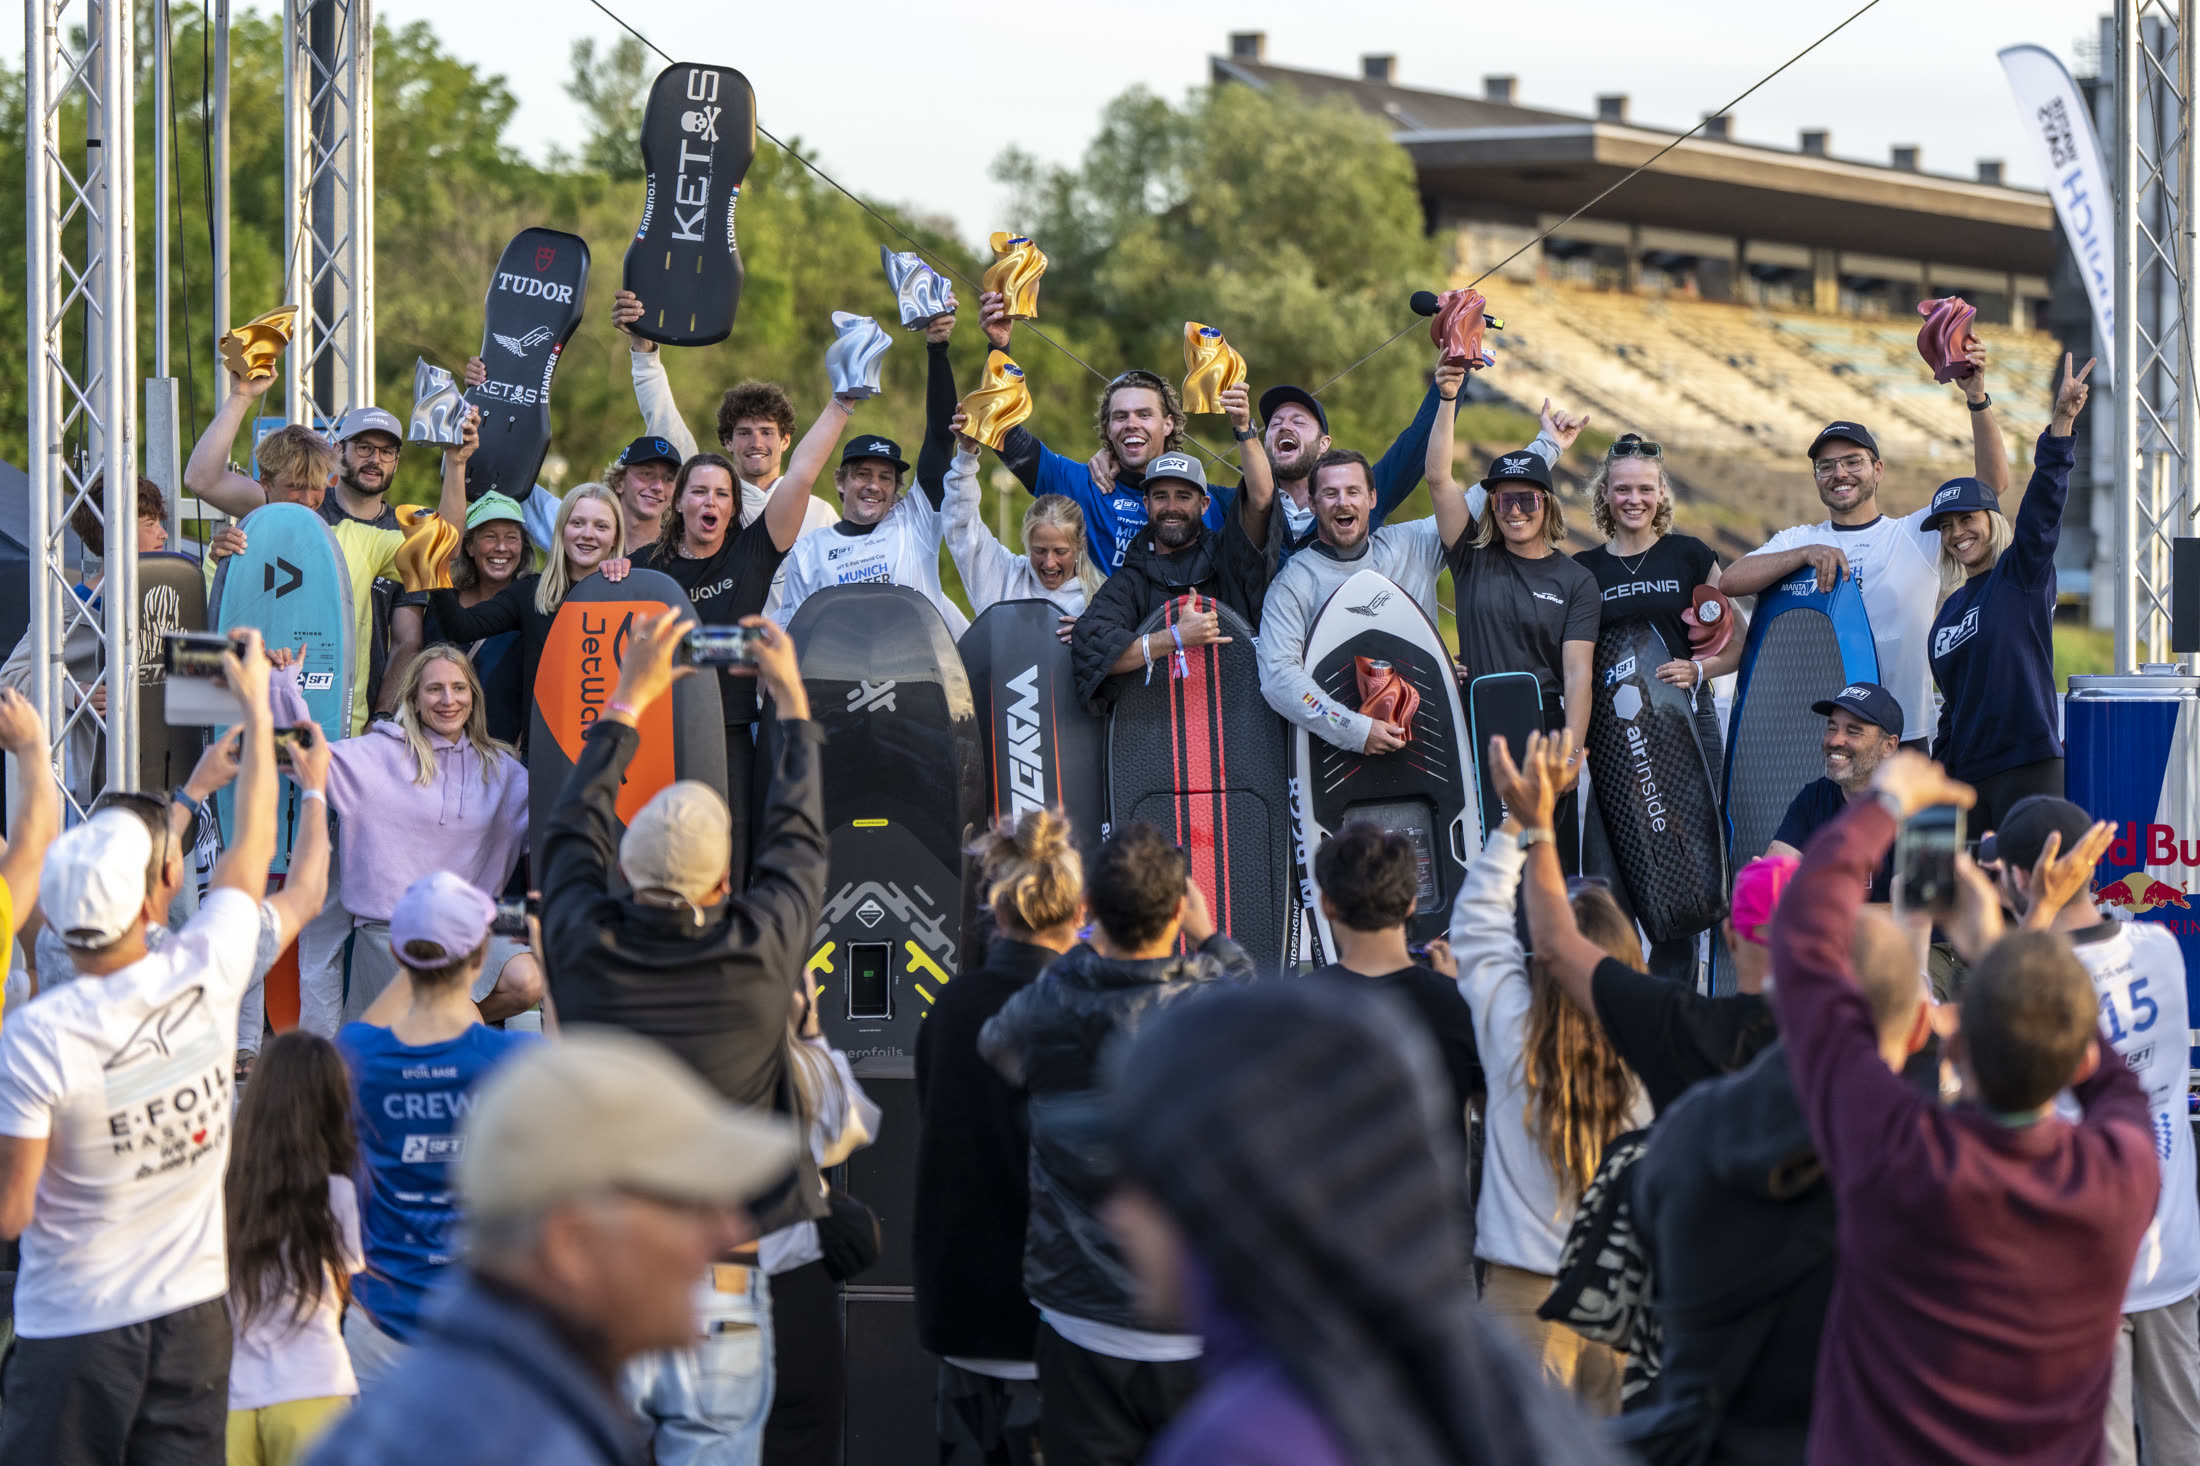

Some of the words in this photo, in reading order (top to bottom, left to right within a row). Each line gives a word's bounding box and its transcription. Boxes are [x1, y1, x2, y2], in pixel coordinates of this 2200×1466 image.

[498, 272, 574, 304] TUDOR
[838, 562, 888, 584] MUNICH
[1781, 583, 1807, 592] MANTA
[1617, 659, 1635, 675] SFT
[309, 675, 332, 684] SFT
[1850, 688, 1867, 697] SFT
[1627, 725, 1667, 833] airinside
[2100, 977, 2158, 1045] 15
[2128, 1049, 2150, 1066] SFT
[431, 1067, 458, 1079] BASE
[382, 1091, 480, 1120] CREW
[428, 1139, 461, 1154] SFT
